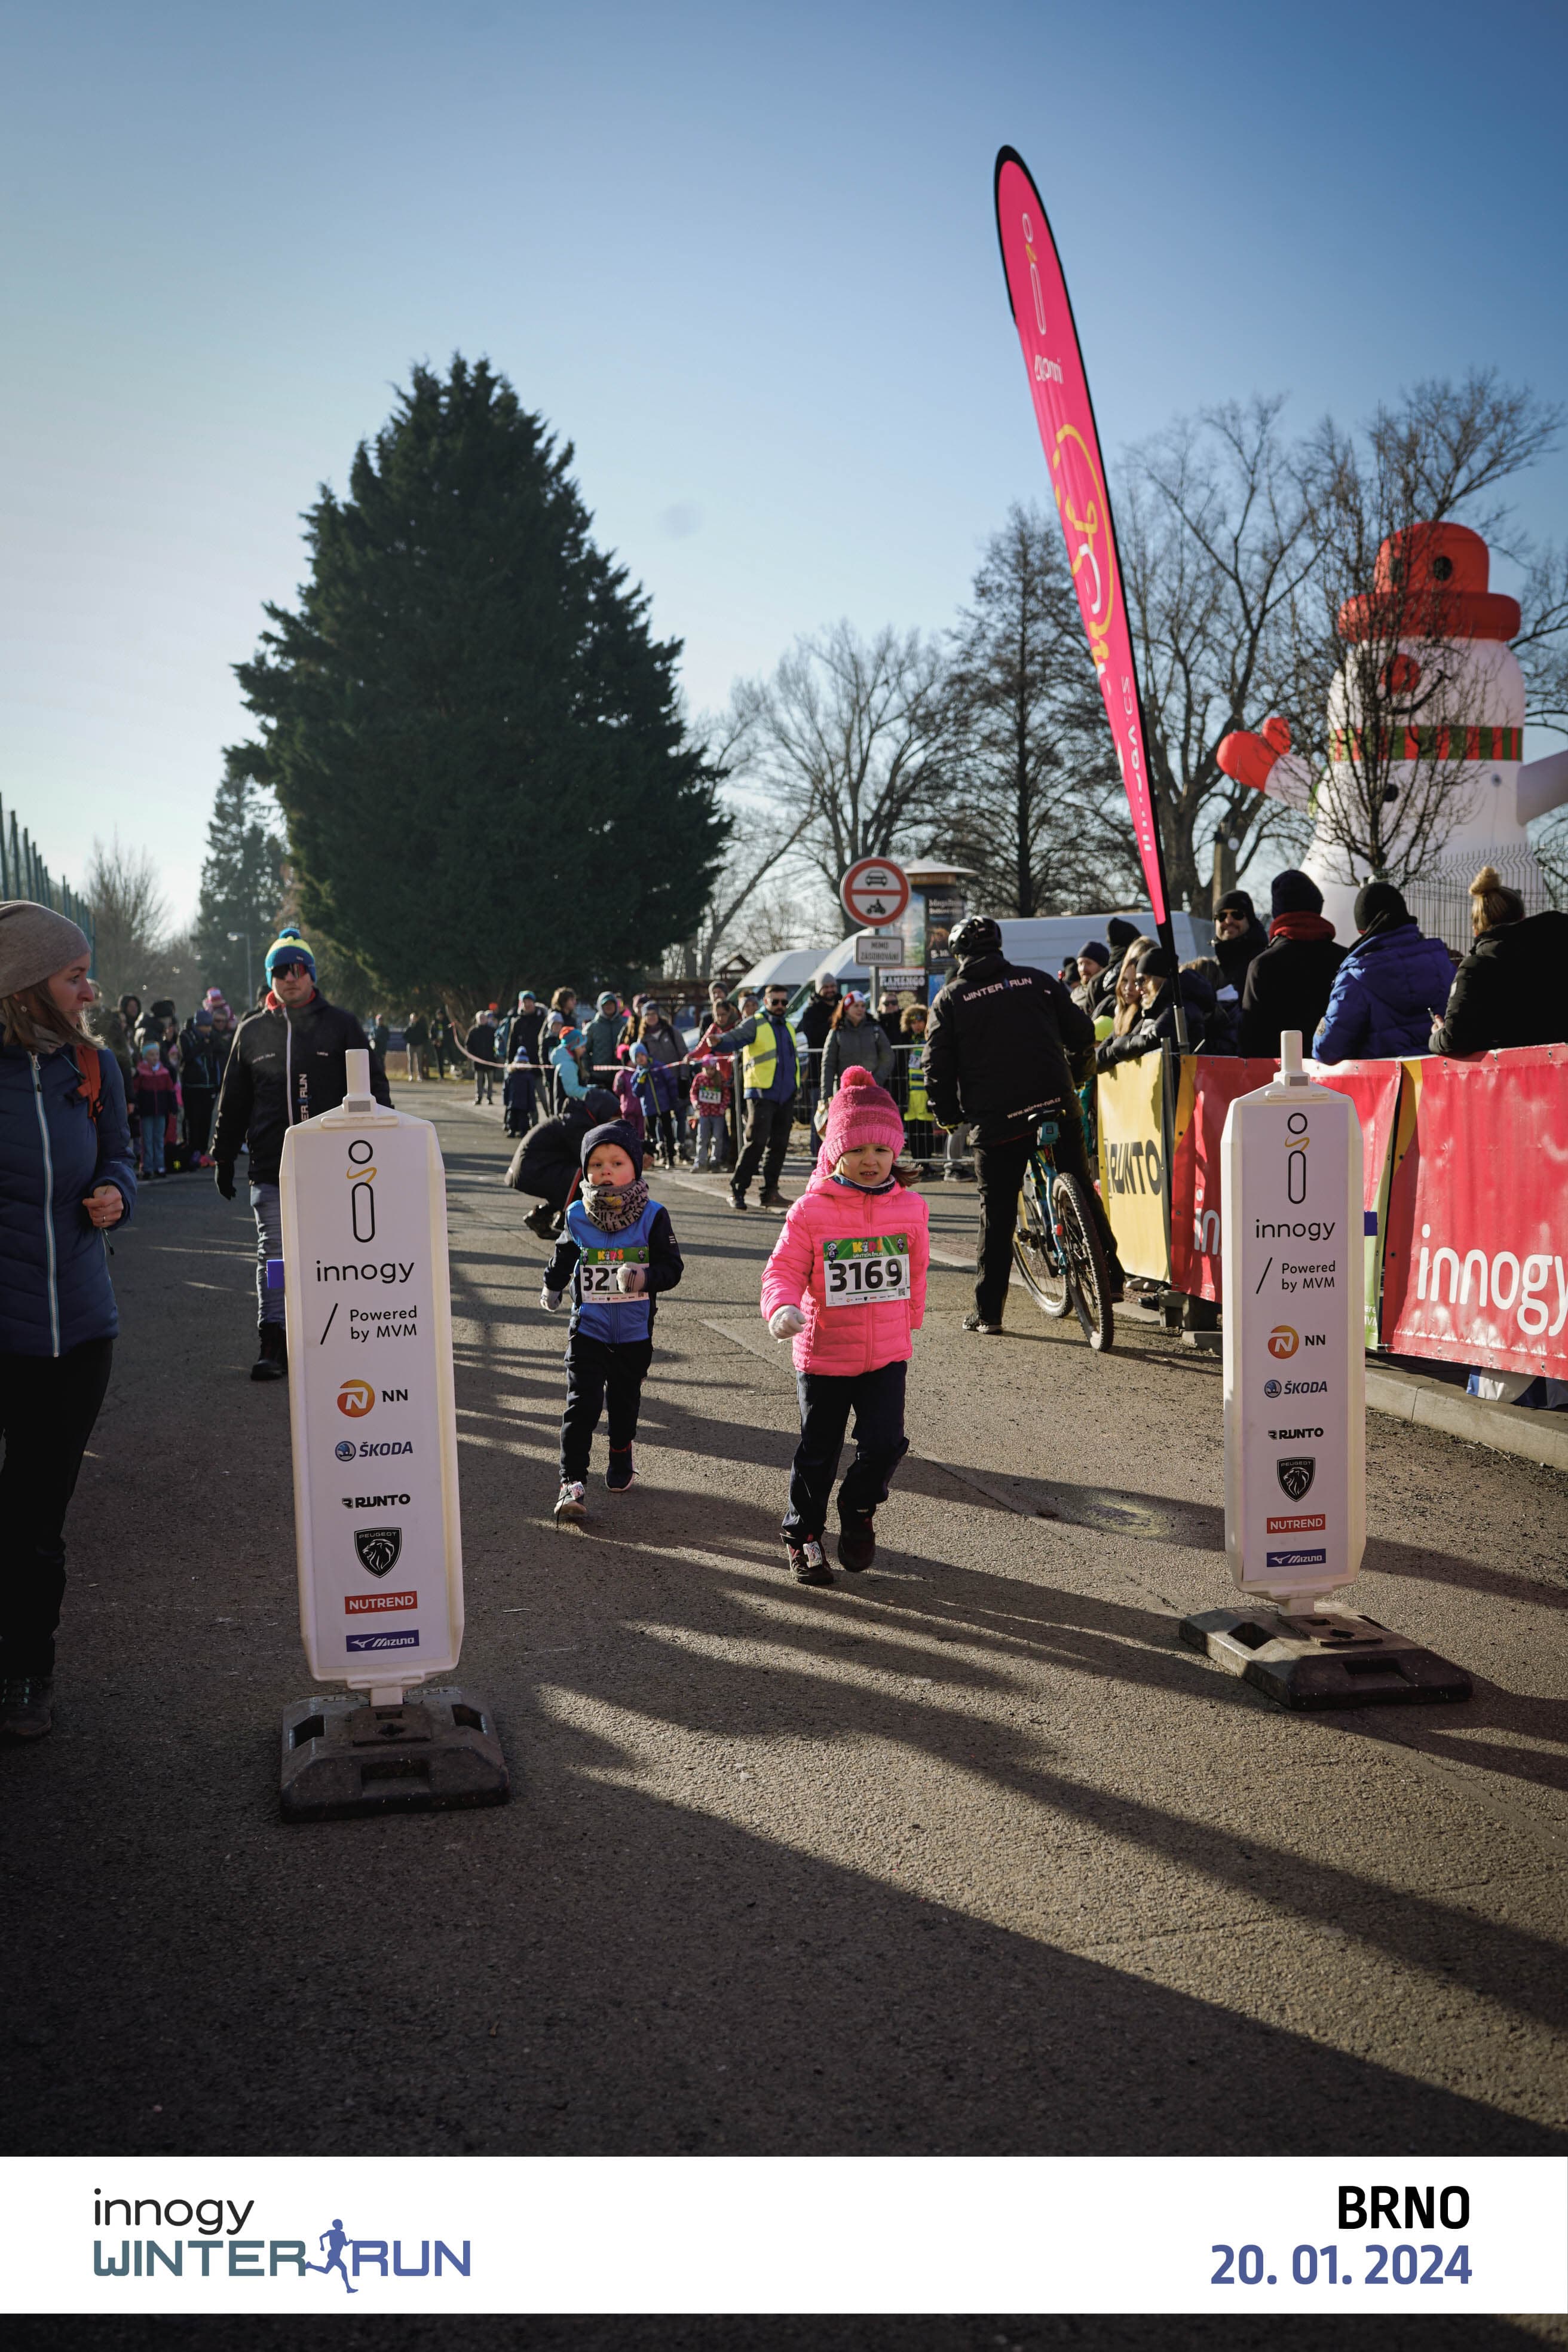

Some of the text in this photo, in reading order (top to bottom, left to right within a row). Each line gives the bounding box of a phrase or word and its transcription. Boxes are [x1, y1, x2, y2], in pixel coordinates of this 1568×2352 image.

[963, 977, 1033, 1002] WINTER RUN
[1255, 1219, 1336, 1241] innogy
[316, 1260, 415, 1284] innogy
[1282, 1260, 1336, 1275] Powered
[829, 1258, 902, 1293] 3169
[1282, 1276, 1335, 1293] by MVM
[350, 1306, 417, 1321] Powered
[350, 1324, 417, 1343] by MVM
[1305, 1334, 1326, 1346] NN
[1284, 1380, 1328, 1395] ŠKODA
[382, 1389, 409, 1402] NN
[1279, 1427, 1324, 1440] RUNTO
[359, 1441, 414, 1457] ŠKODA
[355, 1494, 411, 1508] RUNTO
[1270, 1518, 1323, 1530] NUTREND
[348, 1595, 414, 1610] NUTREND
